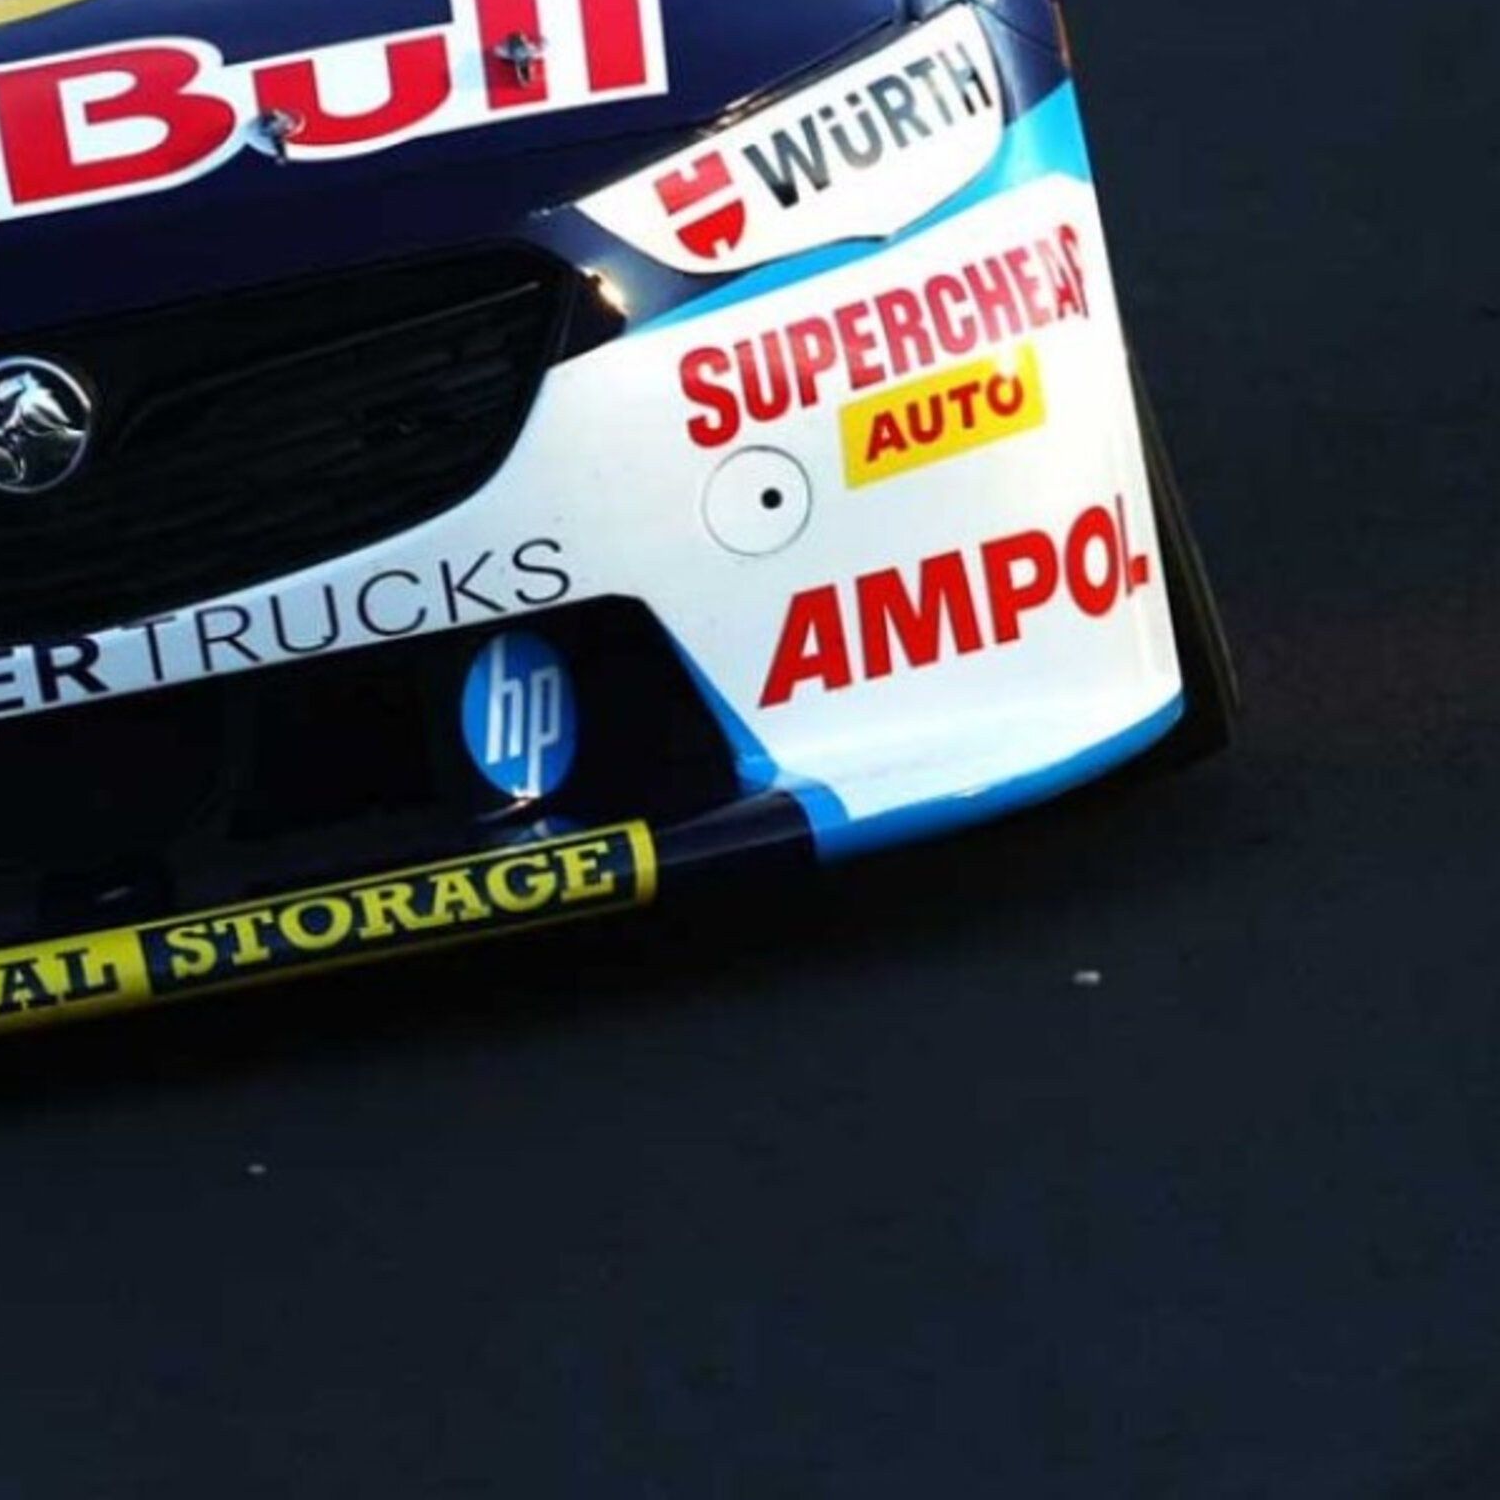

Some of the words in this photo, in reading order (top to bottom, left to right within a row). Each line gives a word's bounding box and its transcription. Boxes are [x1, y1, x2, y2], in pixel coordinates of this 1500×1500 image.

[865, 373, 1025, 462] AUTO
[484, 635, 563, 799] hp
[164, 840, 614, 979] STORAGE
